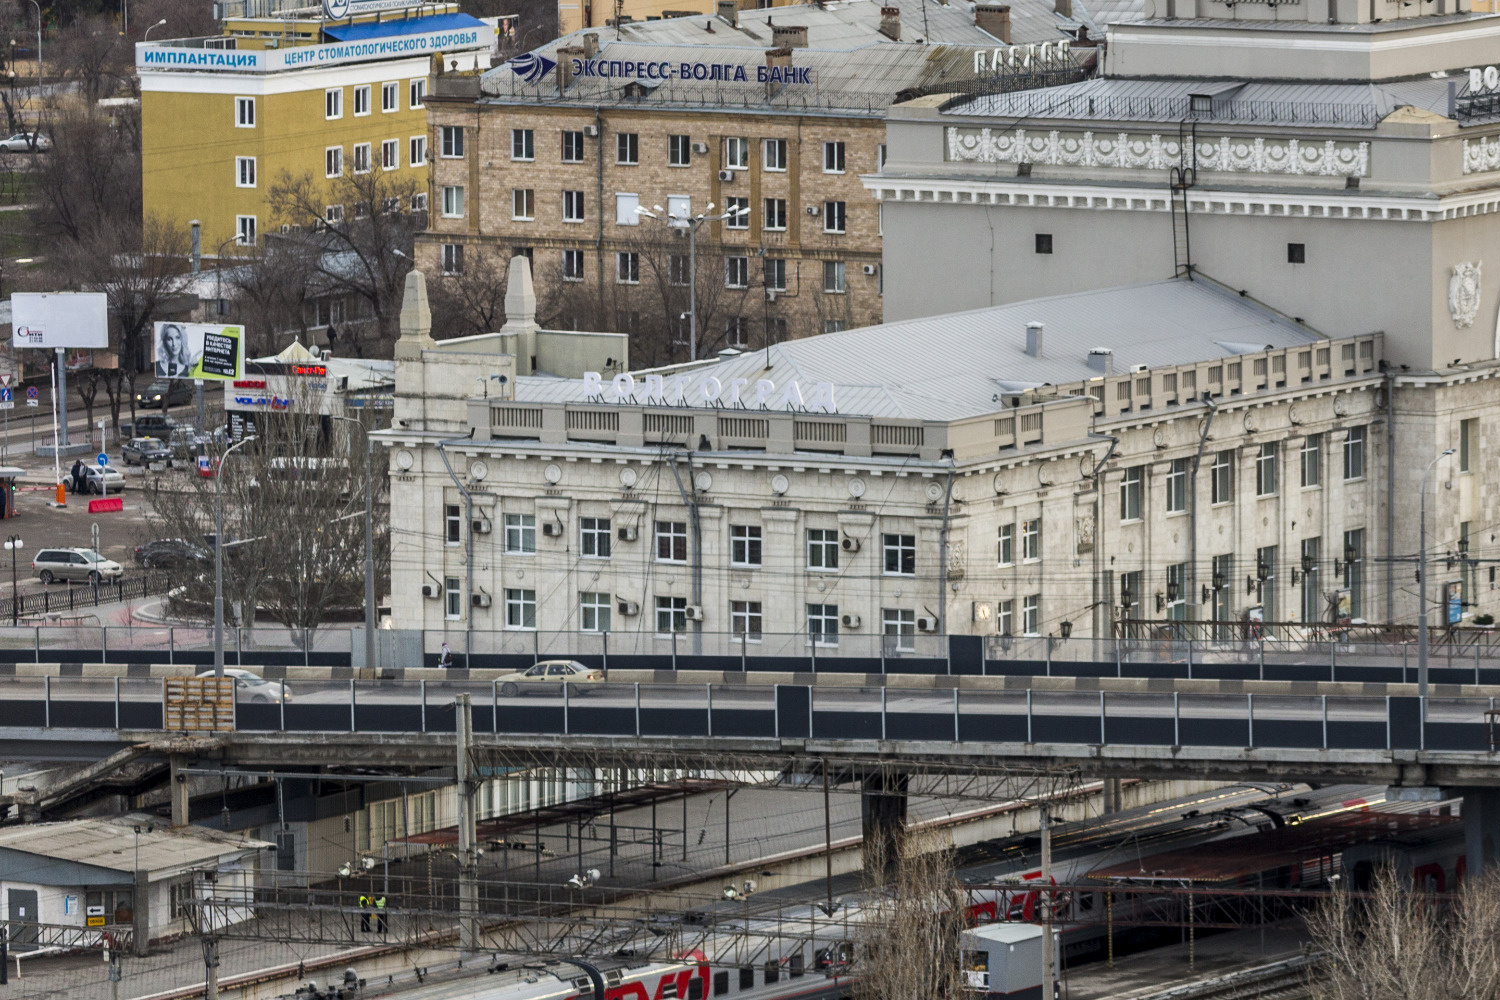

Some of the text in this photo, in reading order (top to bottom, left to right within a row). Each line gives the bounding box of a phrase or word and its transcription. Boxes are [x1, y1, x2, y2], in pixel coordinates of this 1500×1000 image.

[144, 51, 257, 67] ИМПЛАНТАЦИЯ
[284, 31, 478, 65] ЦЕНТР СТОМАТОЛОГИЧЕСКОГО ЗДОРОВЬЯ
[572, 58, 813, 85] ЭКСПРЕСС-ВОЛГА БАНК
[583, 371, 837, 413] ВОЛГОГРАД
